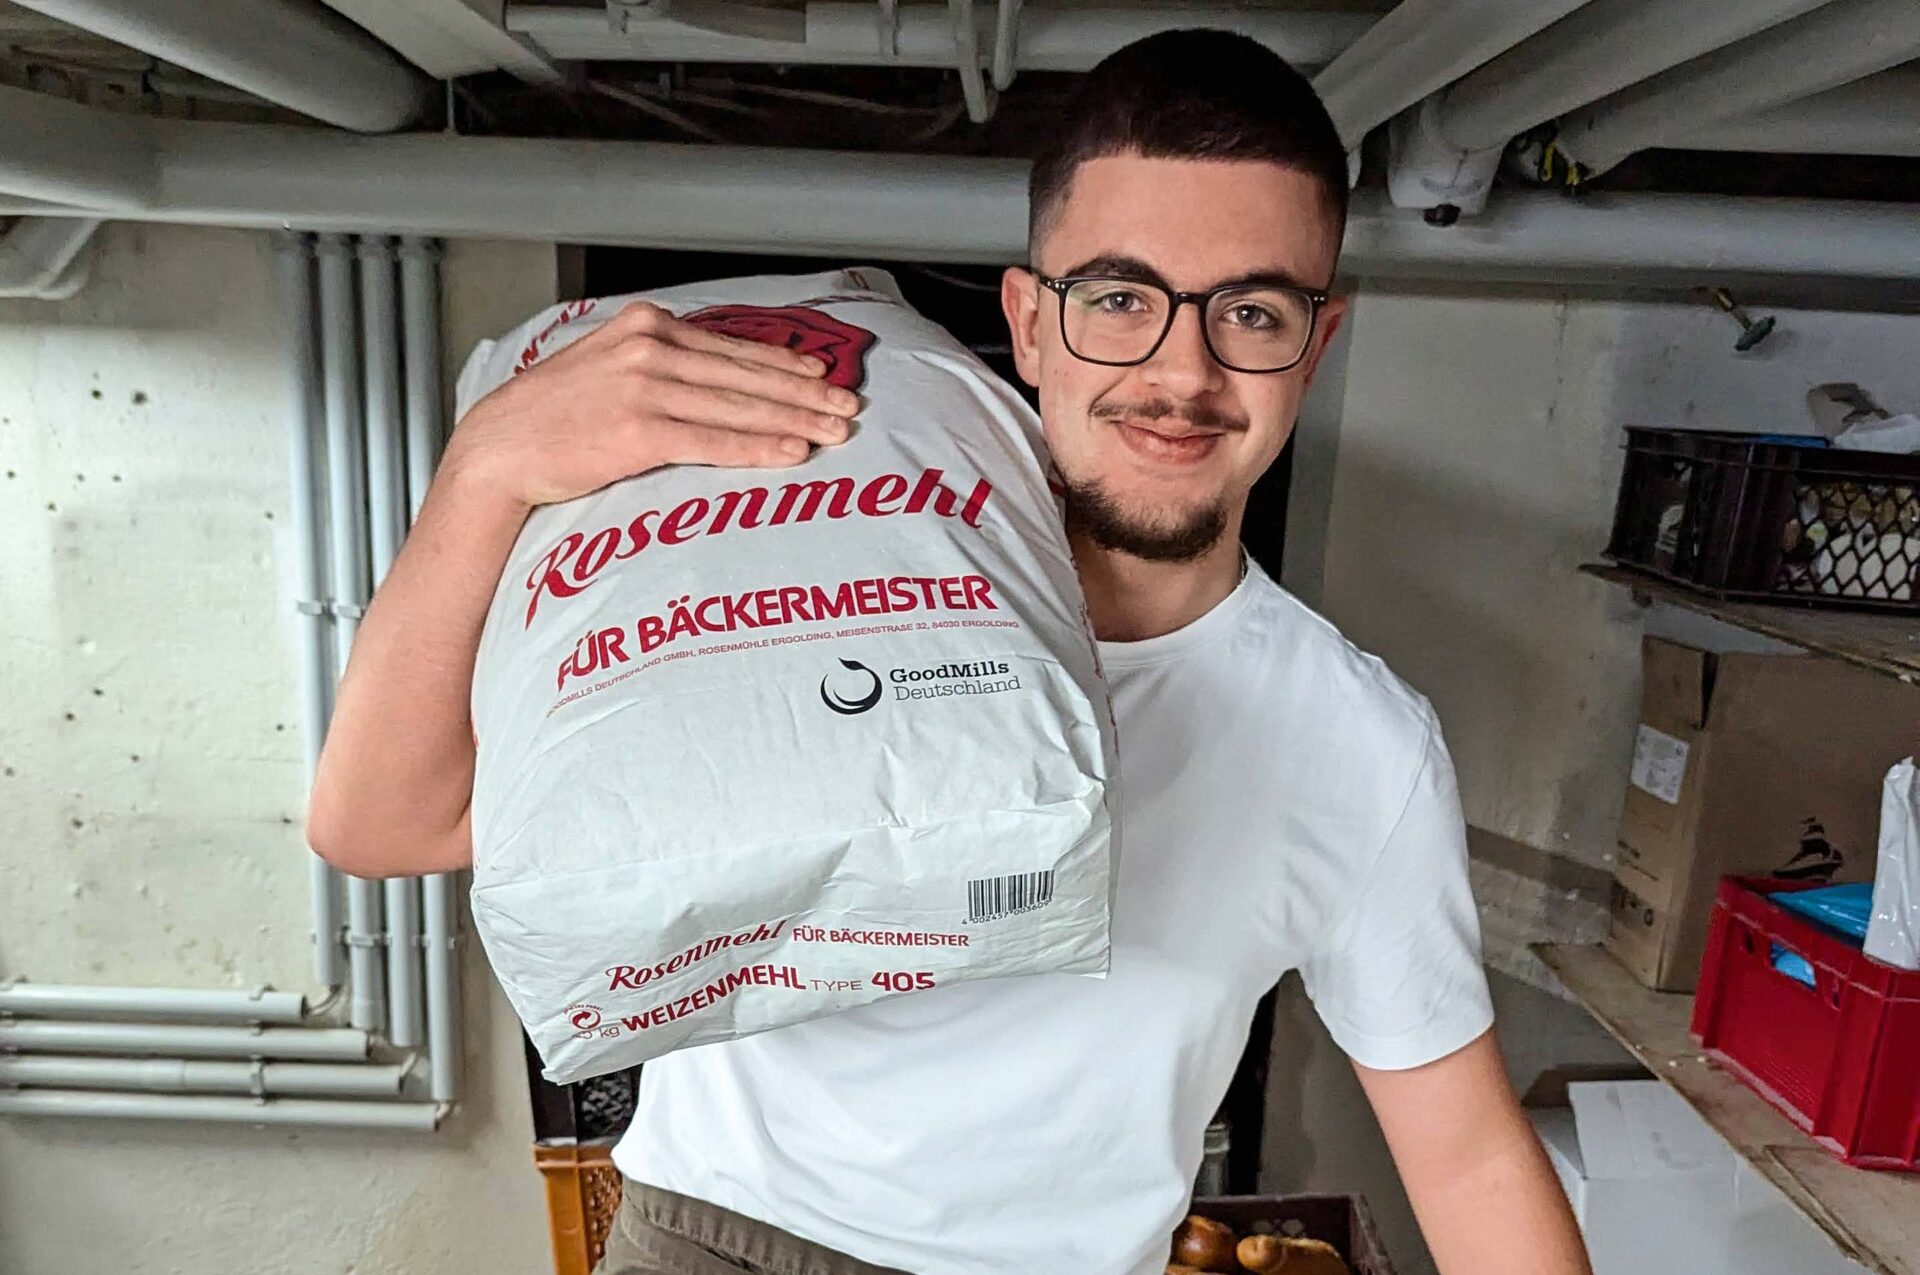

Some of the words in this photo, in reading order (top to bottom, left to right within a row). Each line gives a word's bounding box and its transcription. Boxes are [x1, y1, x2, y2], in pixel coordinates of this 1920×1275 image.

[525, 468, 992, 630] Rosenmehl
[556, 626, 631, 693] FÜR
[637, 575, 999, 654] BÄCKERMEISTER
[595, 656, 661, 691] DEUTSCHLAND
[663, 649, 697, 662] GMBH,
[698, 639, 770, 656] ROSENMÜHLE
[771, 631, 835, 646] ERGOLDING,
[915, 622, 930, 631] 32,
[932, 620, 960, 629] 84030
[962, 620, 1020, 629] ERGOLDING
[889, 660, 1010, 683] GoodMills
[893, 675, 1022, 701] Deutschland
[605, 919, 788, 991] Rosenmehl
[793, 926, 827, 942] FÜR
[830, 928, 970, 947] BÄCKERMEISTER
[599, 1026, 620, 1038] kg
[621, 964, 807, 1031] WEIZENMEHL
[809, 979, 864, 992] TYPE
[870, 971, 936, 992] 405
